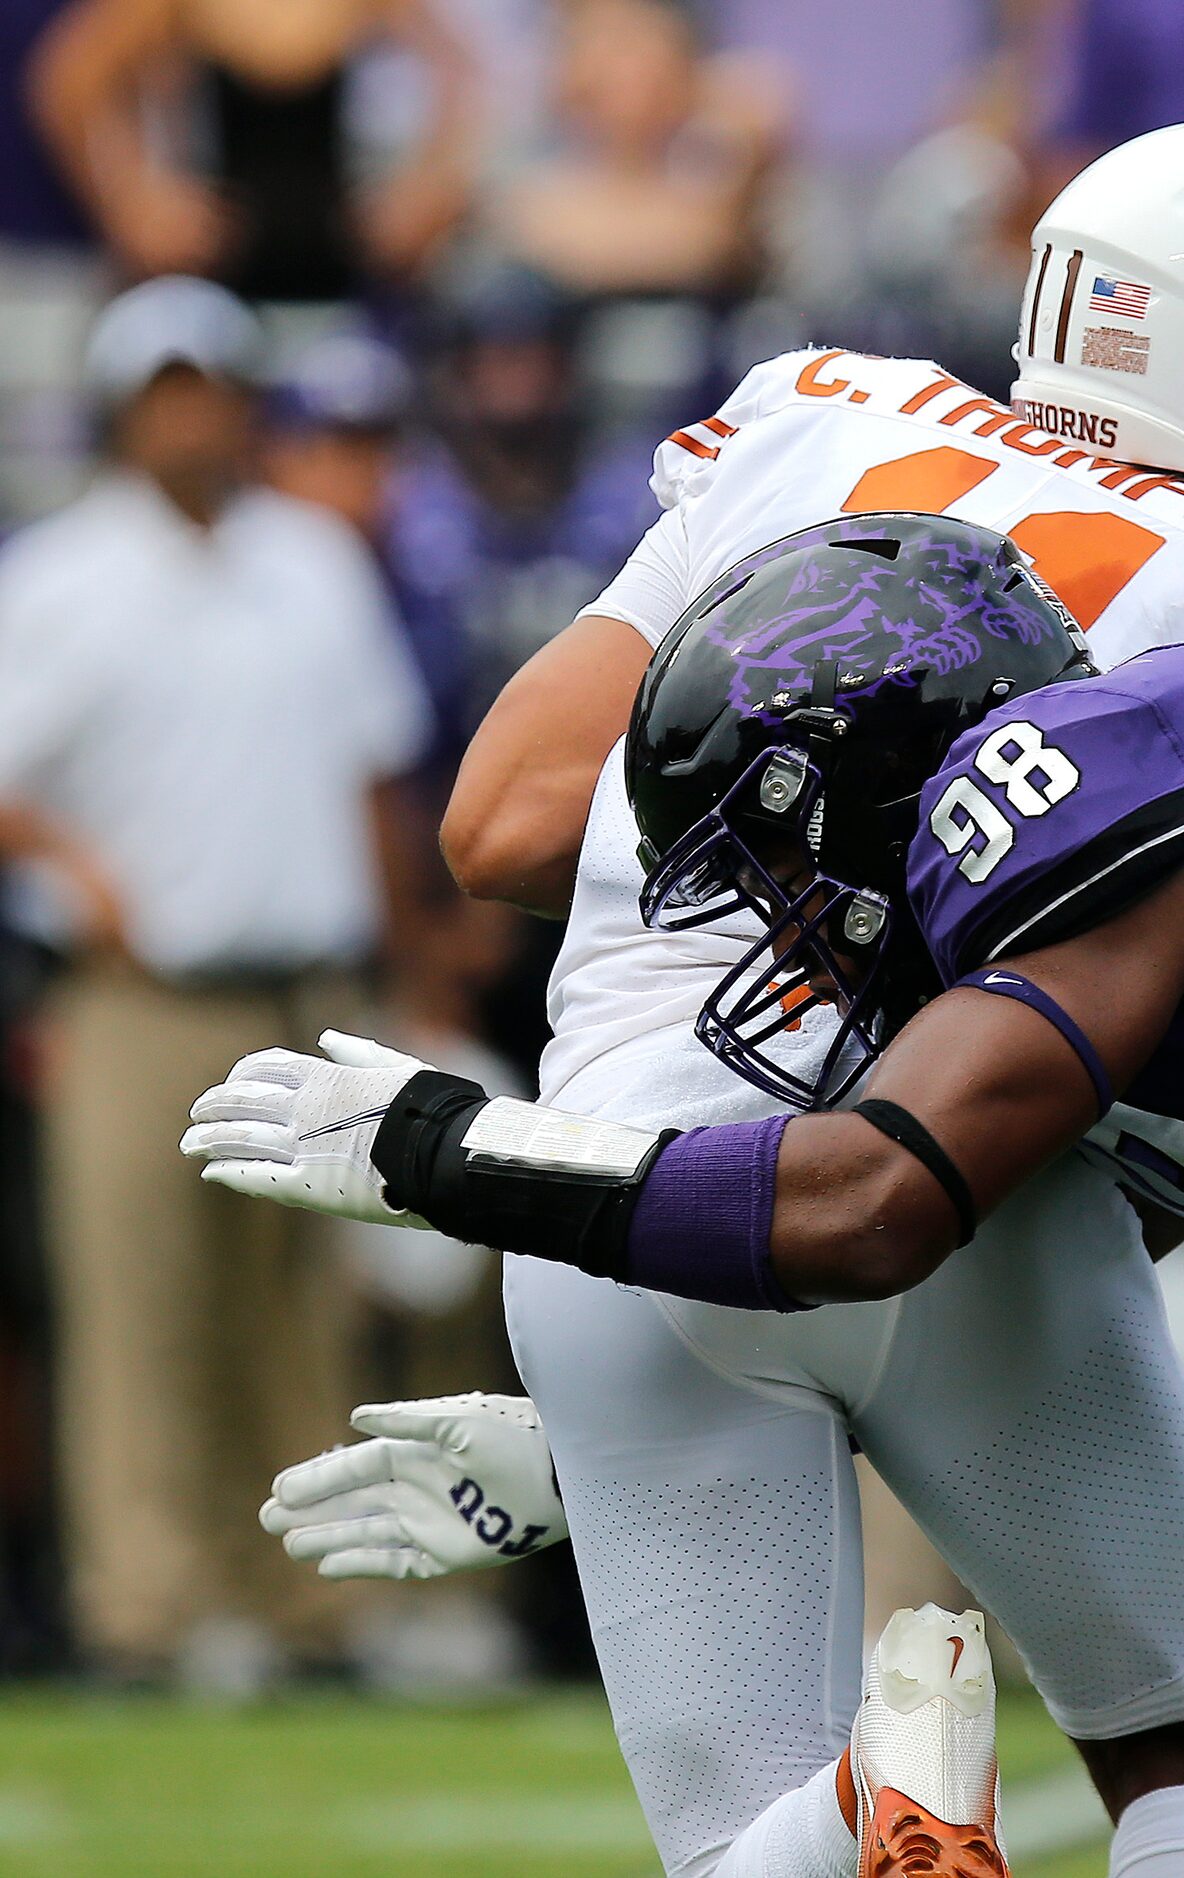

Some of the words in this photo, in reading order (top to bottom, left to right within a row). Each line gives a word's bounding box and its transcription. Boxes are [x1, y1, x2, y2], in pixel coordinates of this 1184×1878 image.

[793, 350, 871, 405] C.
[929, 719, 1082, 887] 98
[448, 1476, 551, 1557] TCU
